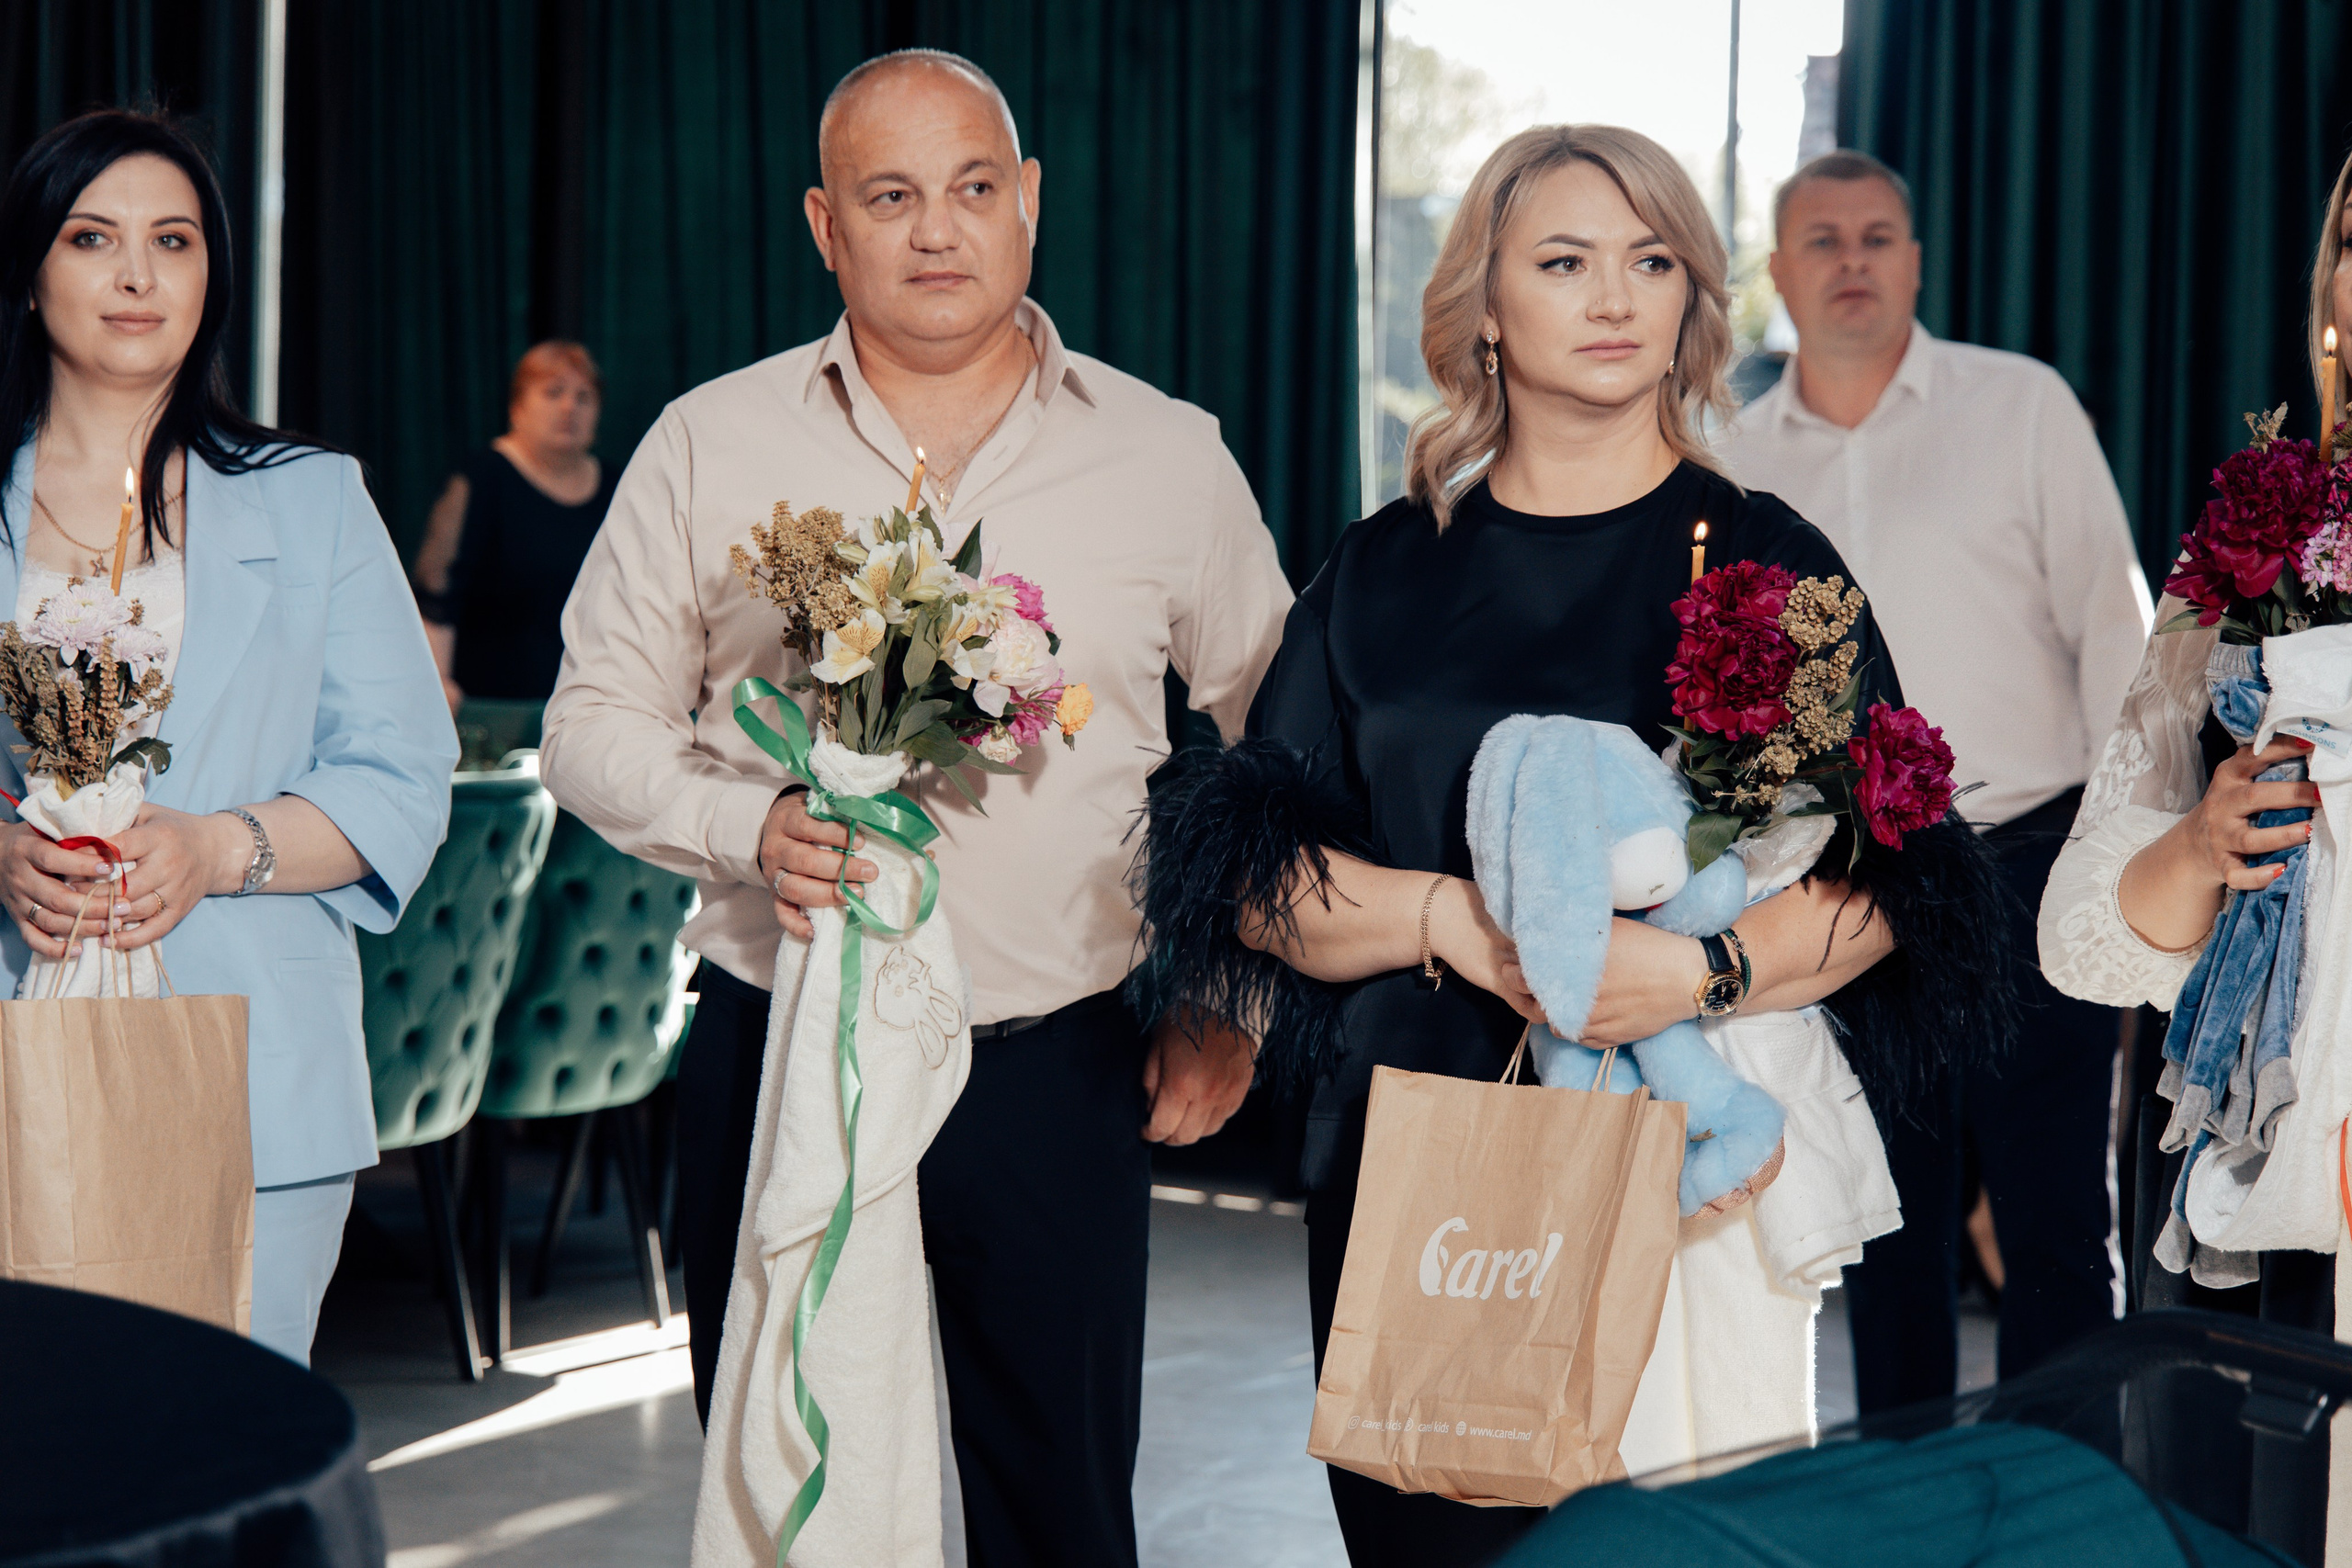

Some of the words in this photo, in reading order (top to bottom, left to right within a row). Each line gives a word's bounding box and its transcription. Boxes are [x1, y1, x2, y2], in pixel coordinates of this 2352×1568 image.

[2288, 728, 2336, 750] JOHNSONS
[1419, 1216, 1563, 1301] Carel
[1434, 1421, 1450, 1434] kids
[1470, 1427, 1532, 1441] www.carel.md
